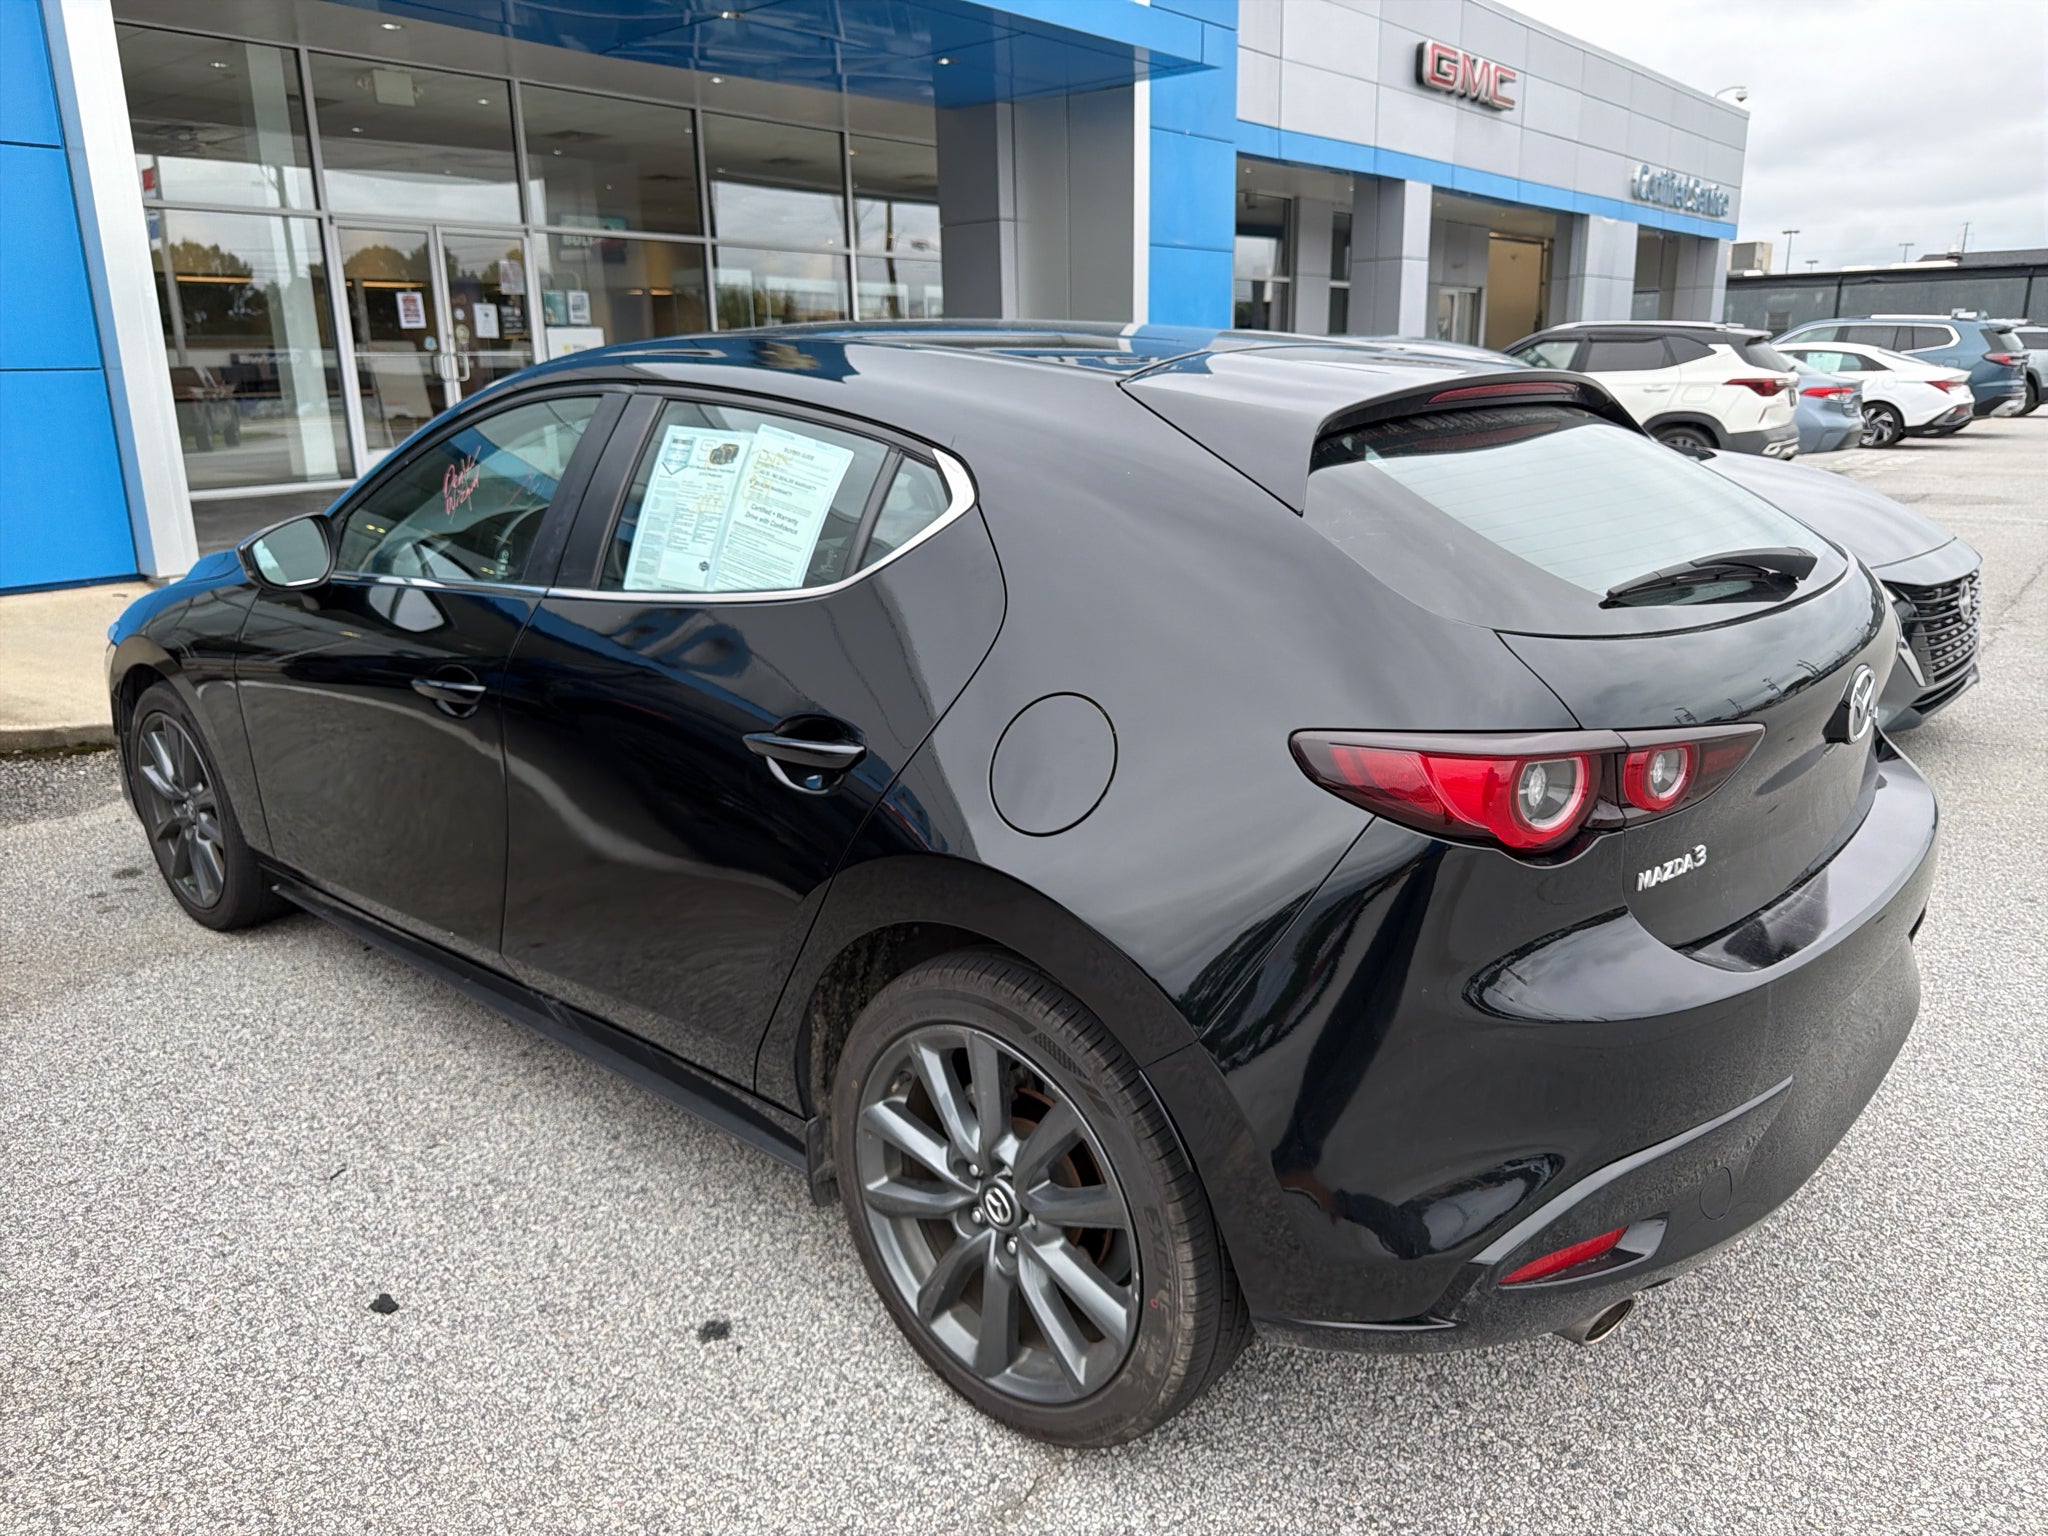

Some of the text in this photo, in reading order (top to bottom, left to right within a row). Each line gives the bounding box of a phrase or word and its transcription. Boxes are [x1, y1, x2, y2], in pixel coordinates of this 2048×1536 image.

[1422, 39, 1516, 110] GMC
[1635, 164, 1730, 217] Certified Service
[745, 511, 798, 535] Drive with Confidence
[751, 503, 772, 516] Certified
[776, 512, 798, 527] Warranty
[1637, 844, 1707, 892] MAZDA3
